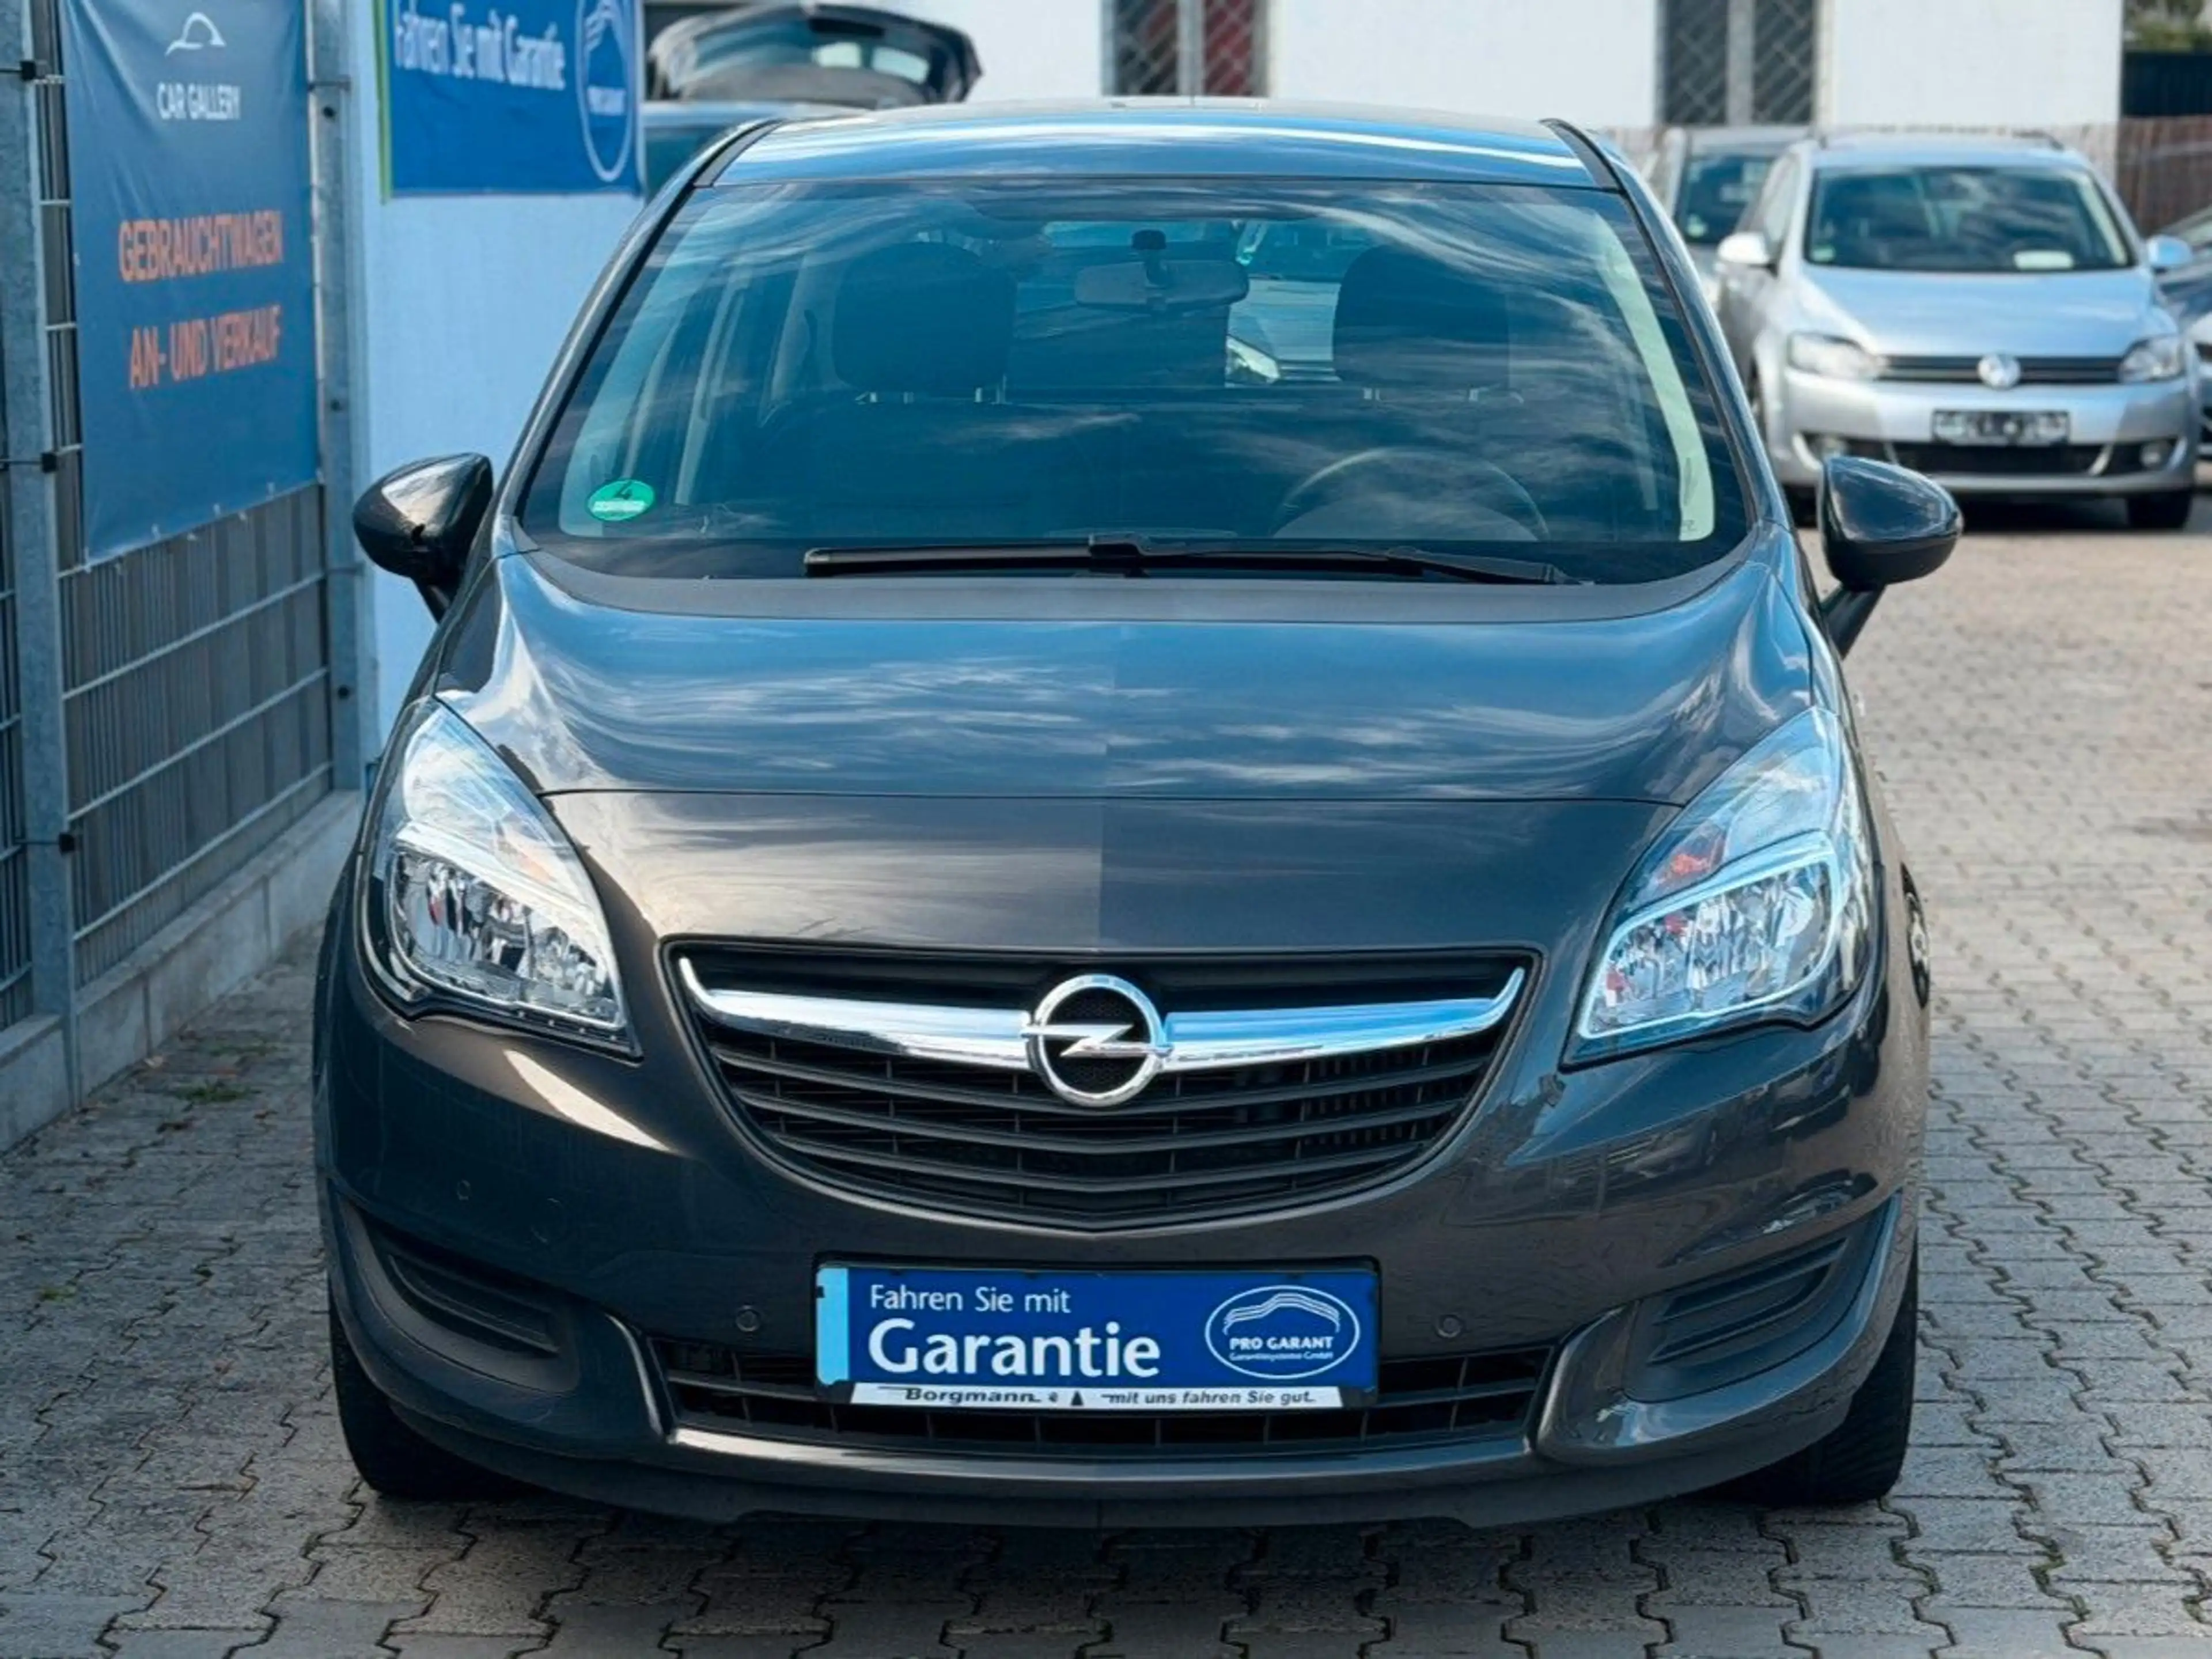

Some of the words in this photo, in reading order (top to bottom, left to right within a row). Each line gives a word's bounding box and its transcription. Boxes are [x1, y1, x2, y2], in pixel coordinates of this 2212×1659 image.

[157, 81, 187, 120] CAR
[129, 324, 166, 390] AN-
[169, 318, 207, 381] UND
[209, 304, 281, 372] VERKAUF
[870, 1284, 963, 1311] Fahren
[974, 1286, 1014, 1313] Sie
[1024, 1289, 1072, 1314] mit
[868, 1317, 1161, 1378] Garantie
[1229, 1337, 1263, 1350] PRO
[1267, 1336, 1335, 1350] GARANT
[1144, 1392, 1177, 1404] uns
[1181, 1389, 1242, 1404] fahren
[1247, 1389, 1275, 1404] Sie
